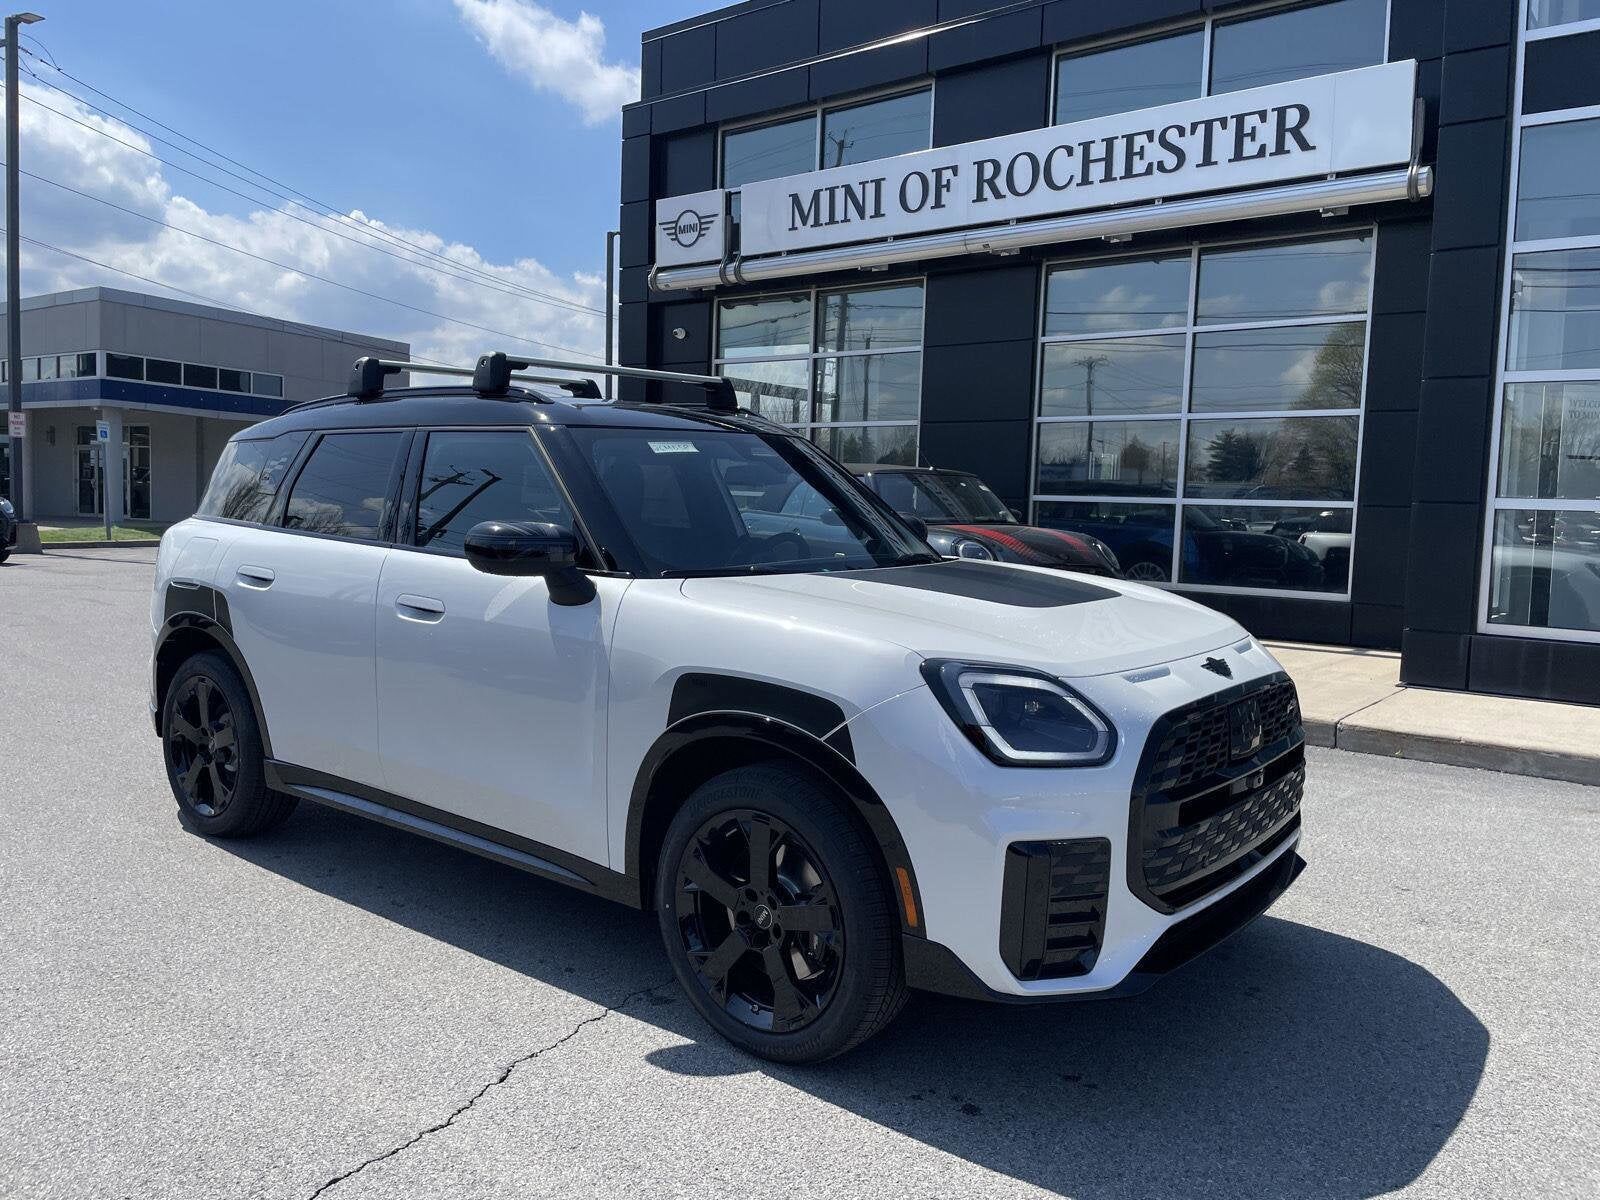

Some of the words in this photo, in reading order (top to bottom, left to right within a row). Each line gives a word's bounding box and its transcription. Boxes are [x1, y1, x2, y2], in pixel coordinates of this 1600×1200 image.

[788, 177, 886, 231] MINI
[899, 165, 958, 213] OF
[971, 103, 1316, 204] ROCHESTER
[678, 223, 698, 234] MINI
